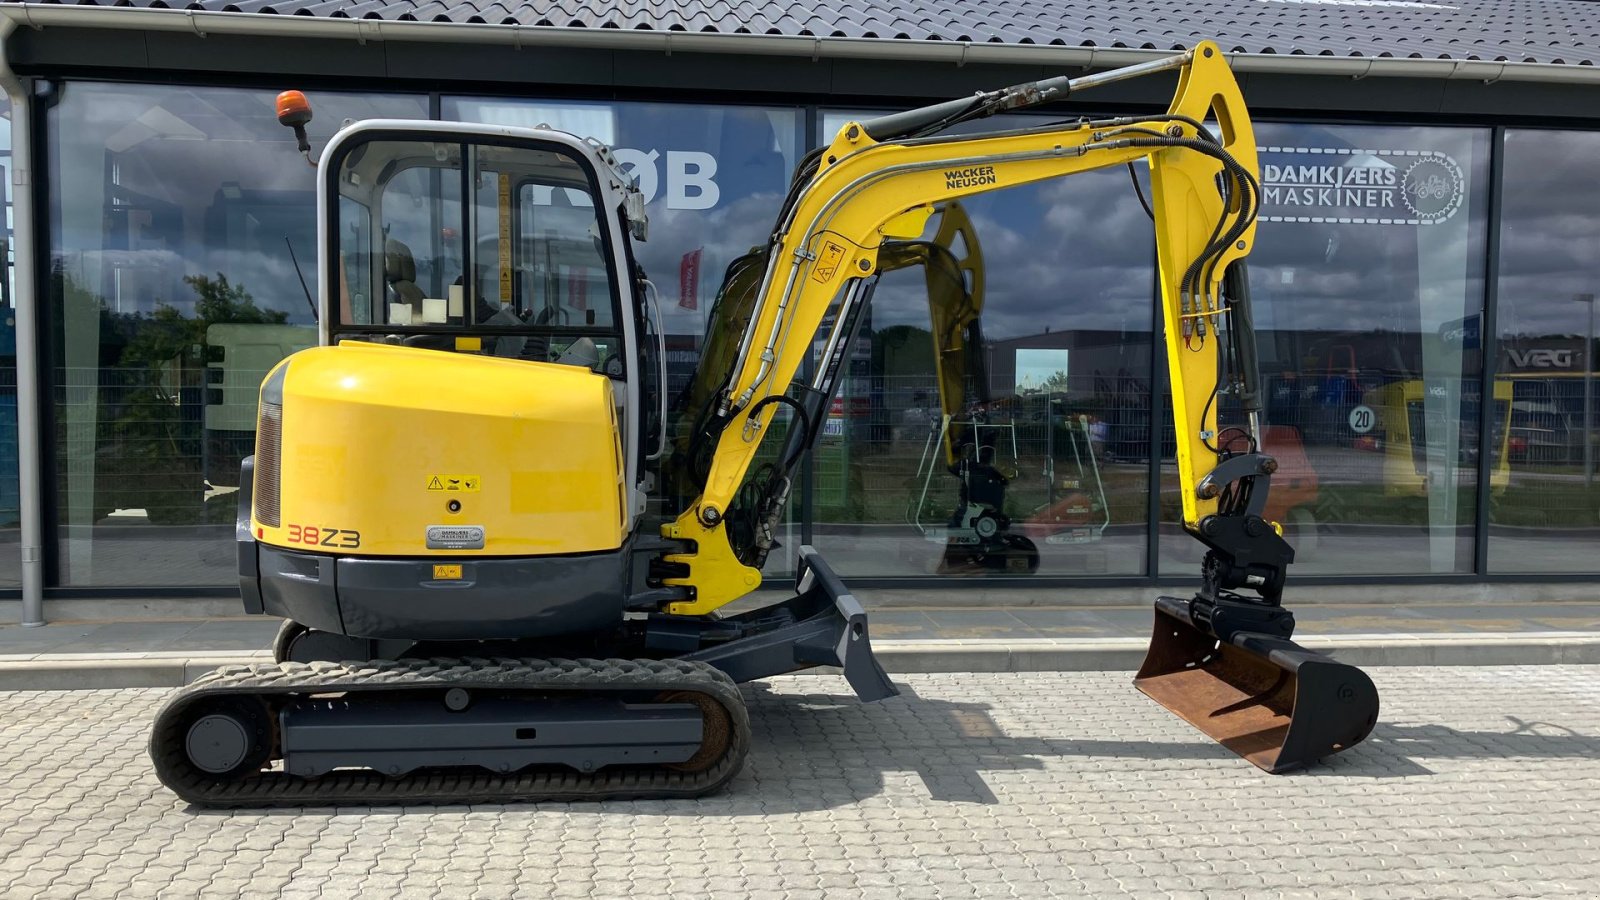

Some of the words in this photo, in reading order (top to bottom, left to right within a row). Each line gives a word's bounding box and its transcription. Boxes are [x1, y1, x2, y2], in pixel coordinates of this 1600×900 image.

[944, 166, 994, 180] WACKER
[946, 175, 996, 189] NEUSON
[1264, 165, 1397, 188] DAMKJÆRS
[1263, 188, 1395, 208] MASKINER
[1355, 411, 1370, 428] 20
[287, 524, 360, 549] 38Z3
